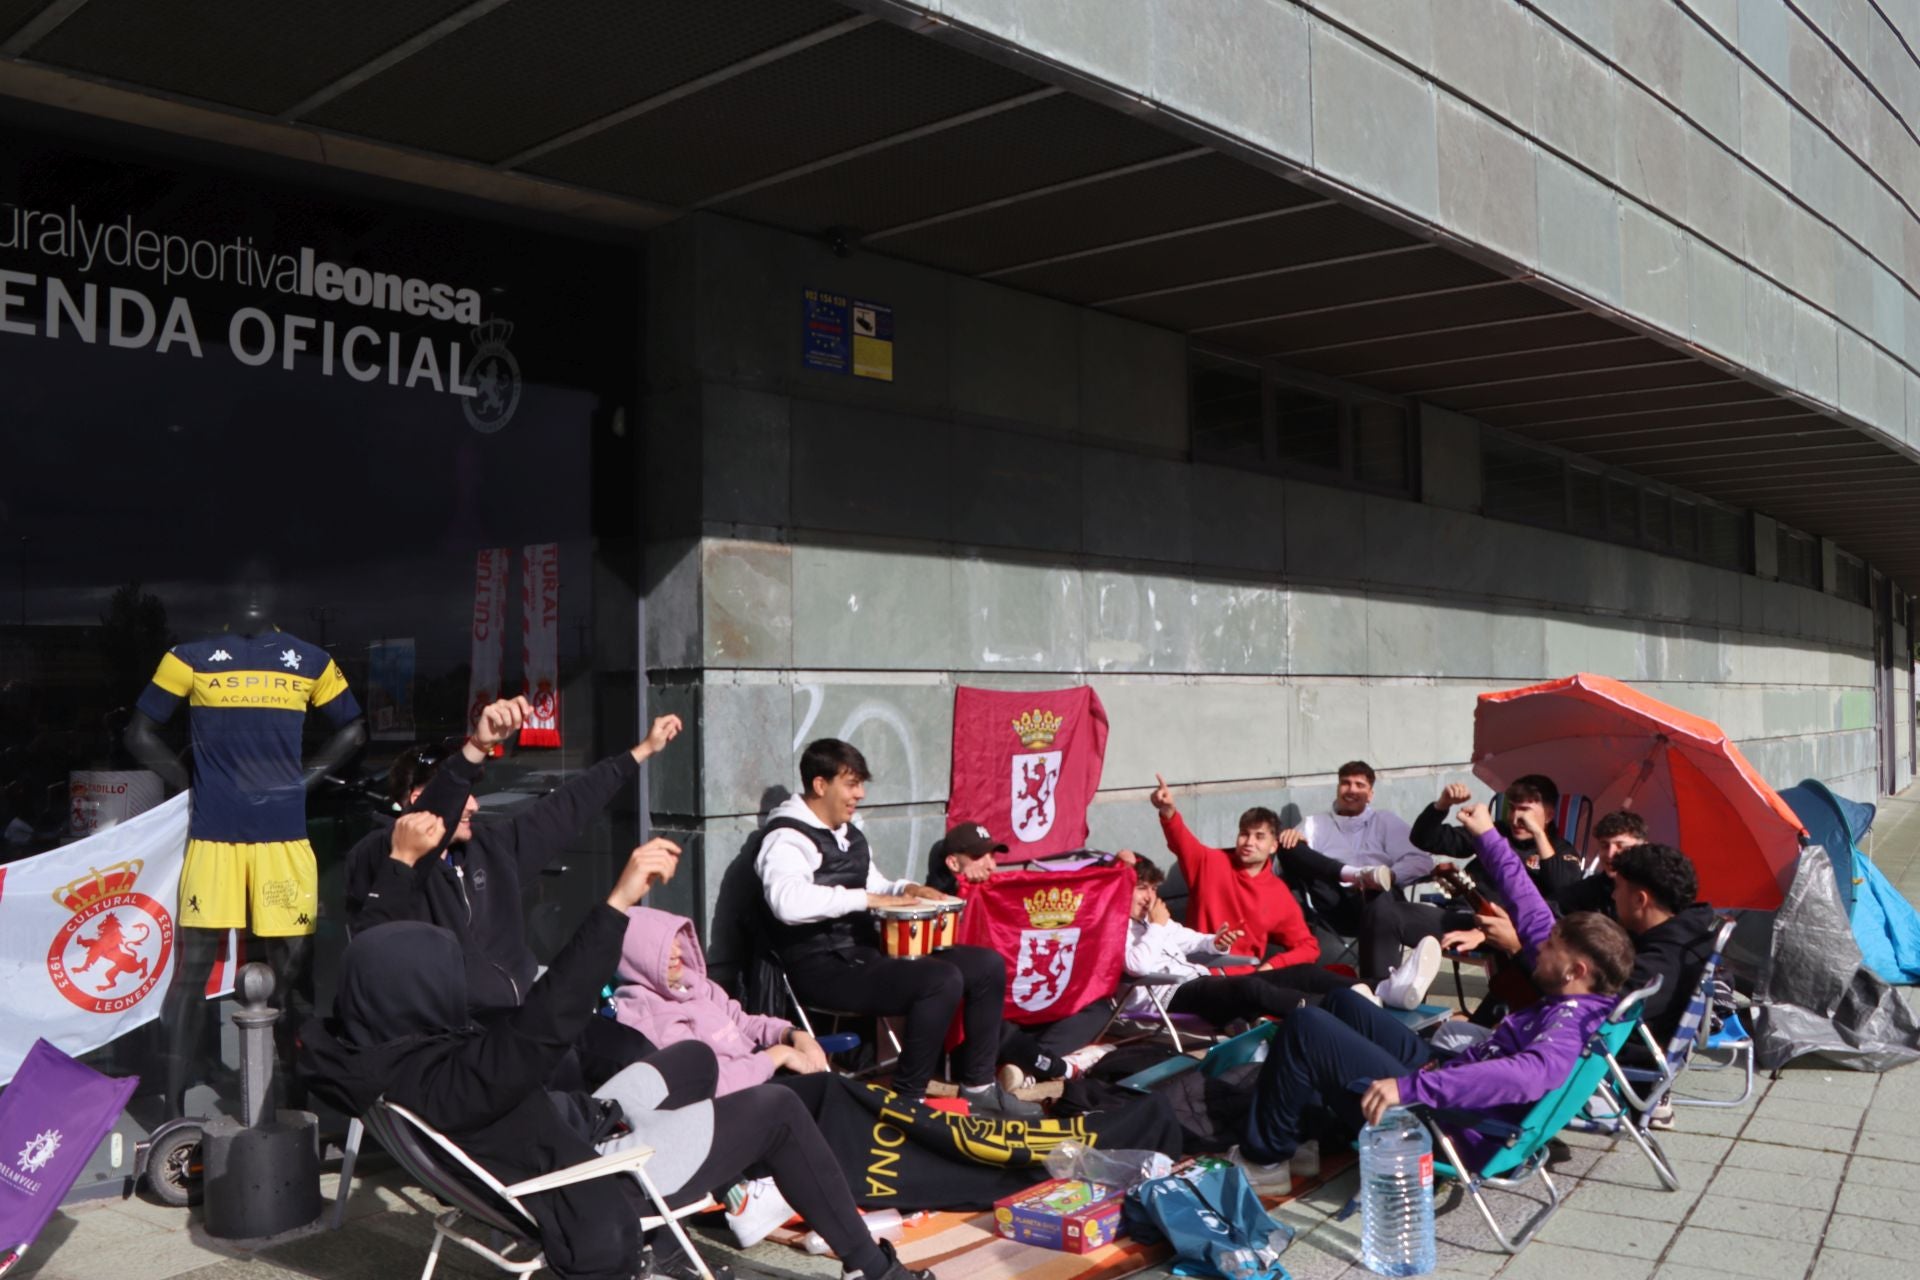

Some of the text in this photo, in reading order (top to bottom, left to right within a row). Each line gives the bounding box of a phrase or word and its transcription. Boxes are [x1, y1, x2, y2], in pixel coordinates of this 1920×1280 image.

[228, 306, 477, 397] OFICIAL
[208, 675, 303, 693] ASPIRE
[221, 695, 290, 705] ACADEMY
[66, 894, 138, 932] CULTURAL
[158, 913, 173, 946] 1923
[49, 955, 70, 988] 1923
[95, 977, 157, 1012] LEONESA
